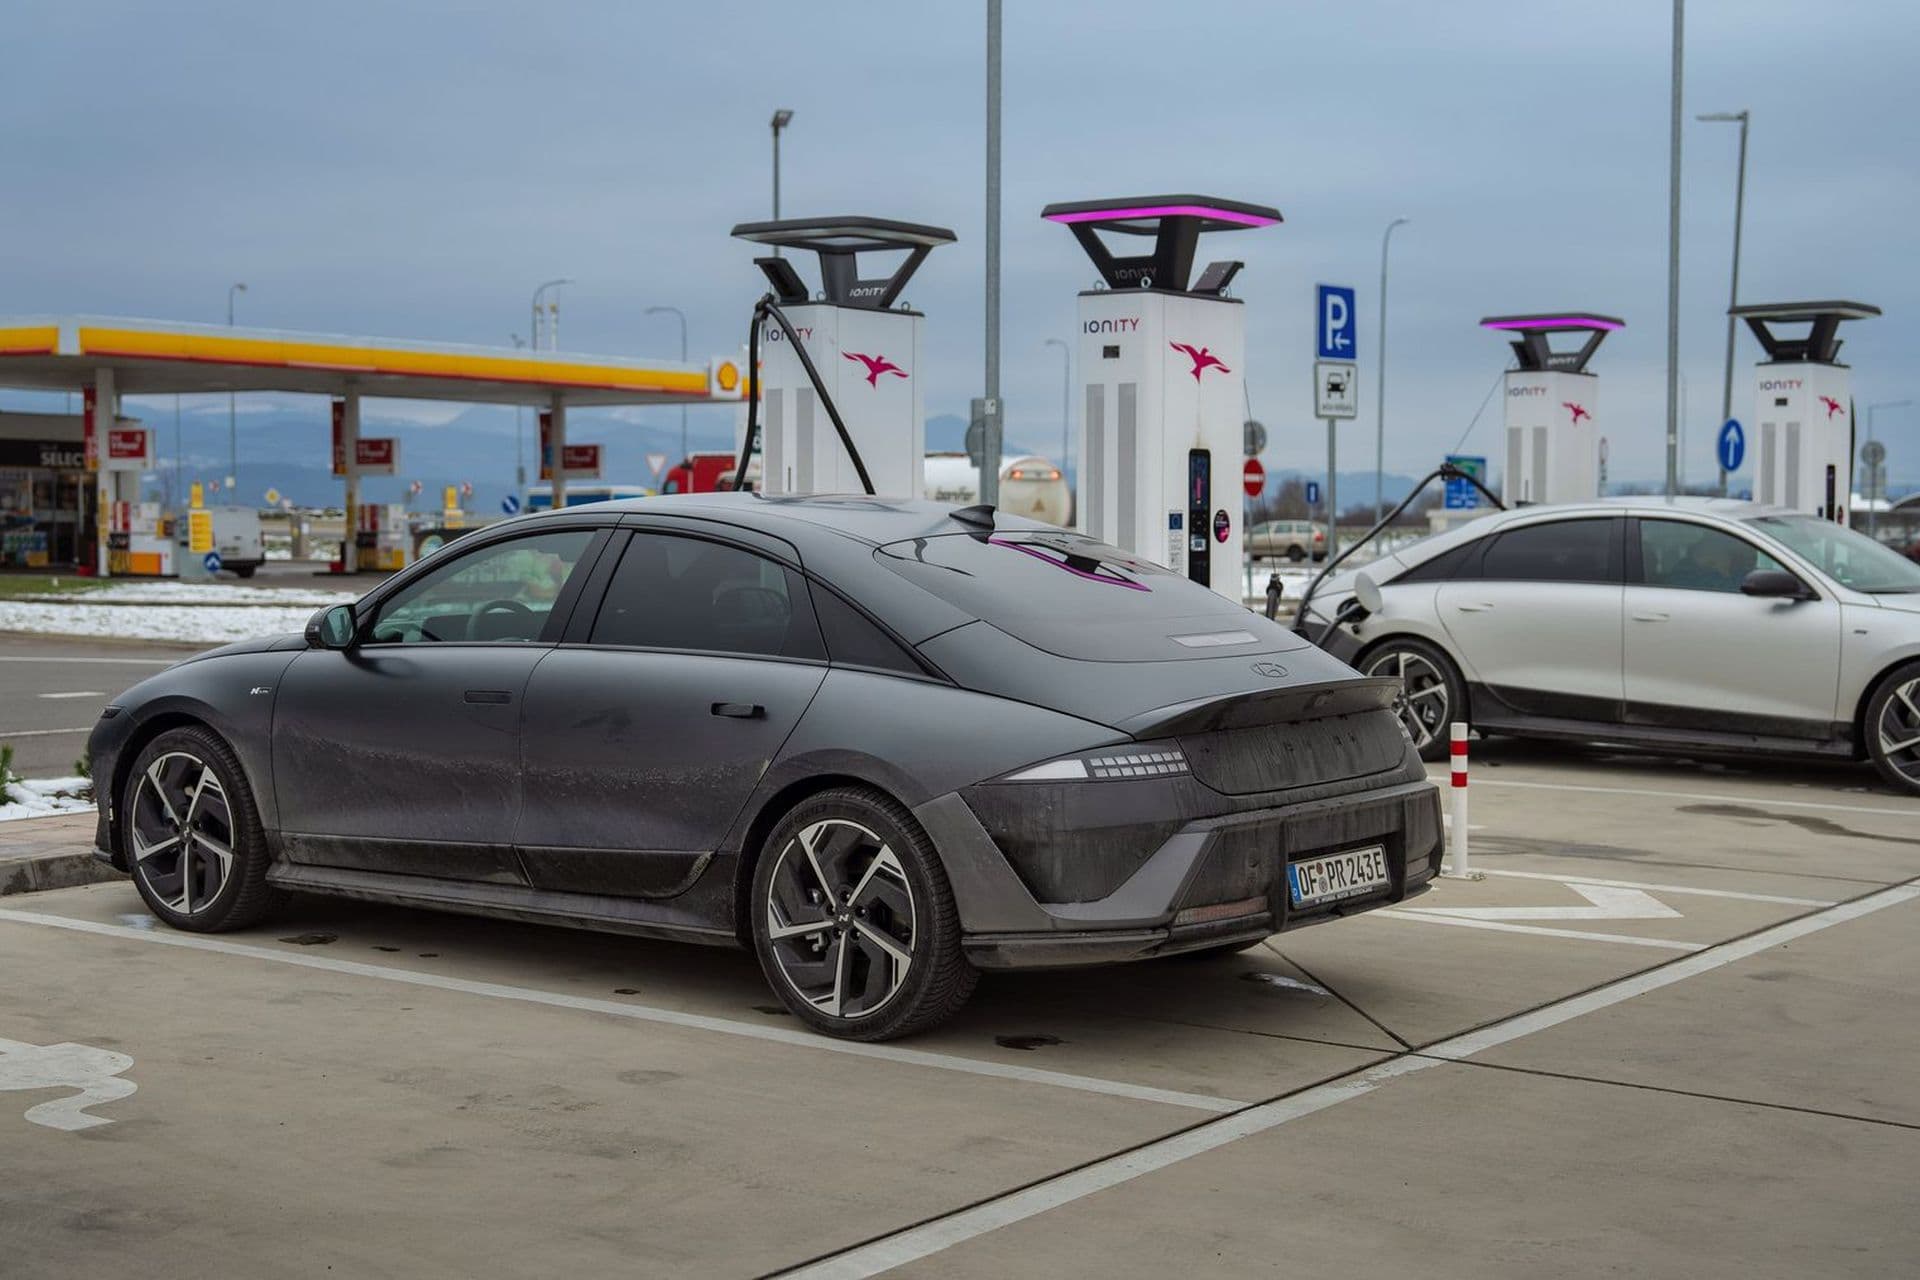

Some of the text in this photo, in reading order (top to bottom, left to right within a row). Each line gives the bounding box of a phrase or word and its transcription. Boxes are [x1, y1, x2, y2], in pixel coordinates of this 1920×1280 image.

[849, 286, 888, 298] IONITY
[1083, 318, 1140, 334] IONITY
[1326, 294, 1348, 350] P
[765, 327, 814, 342] IOTY
[1508, 386, 1547, 397] IONITY
[1759, 380, 1802, 391] IONITY
[40, 452, 84, 466] SELEC
[1299, 865, 1318, 897] OF
[1325, 860, 1347, 890] PR
[1346, 851, 1385, 886] 243E
